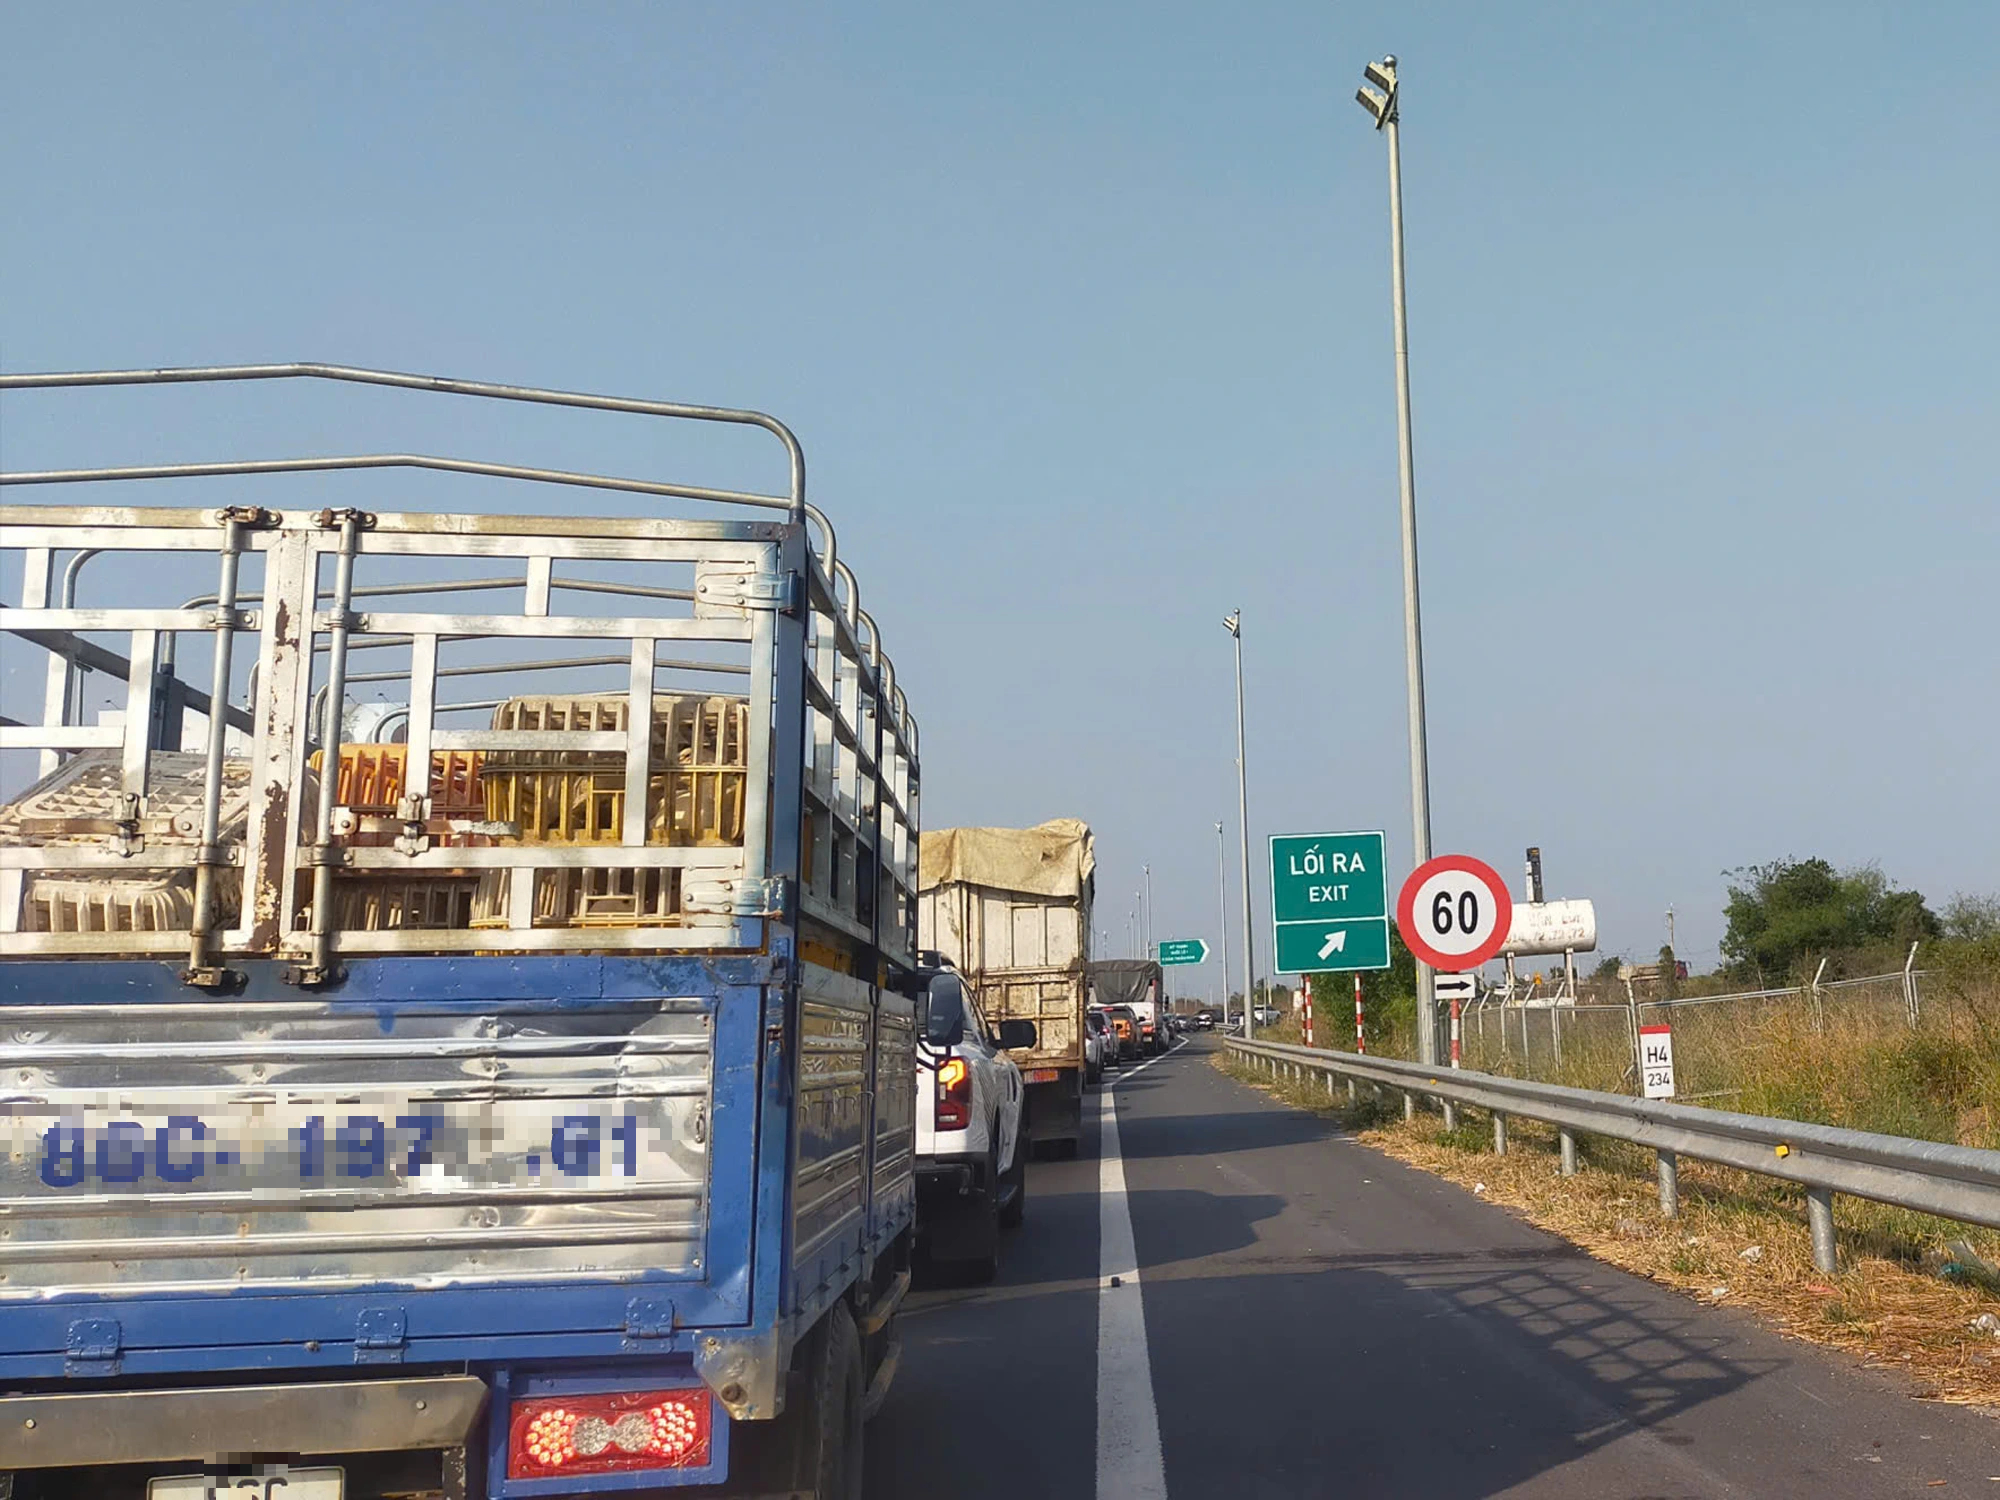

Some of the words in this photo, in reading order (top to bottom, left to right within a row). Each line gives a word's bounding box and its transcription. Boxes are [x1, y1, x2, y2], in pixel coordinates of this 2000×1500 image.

[1290, 844, 1325, 876] LỐI
[1333, 852, 1366, 873] RA
[1309, 884, 1349, 902] EXIT
[1432, 890, 1479, 935] 60
[1647, 1045, 1668, 1063] H4
[1648, 1072, 1670, 1087] 234
